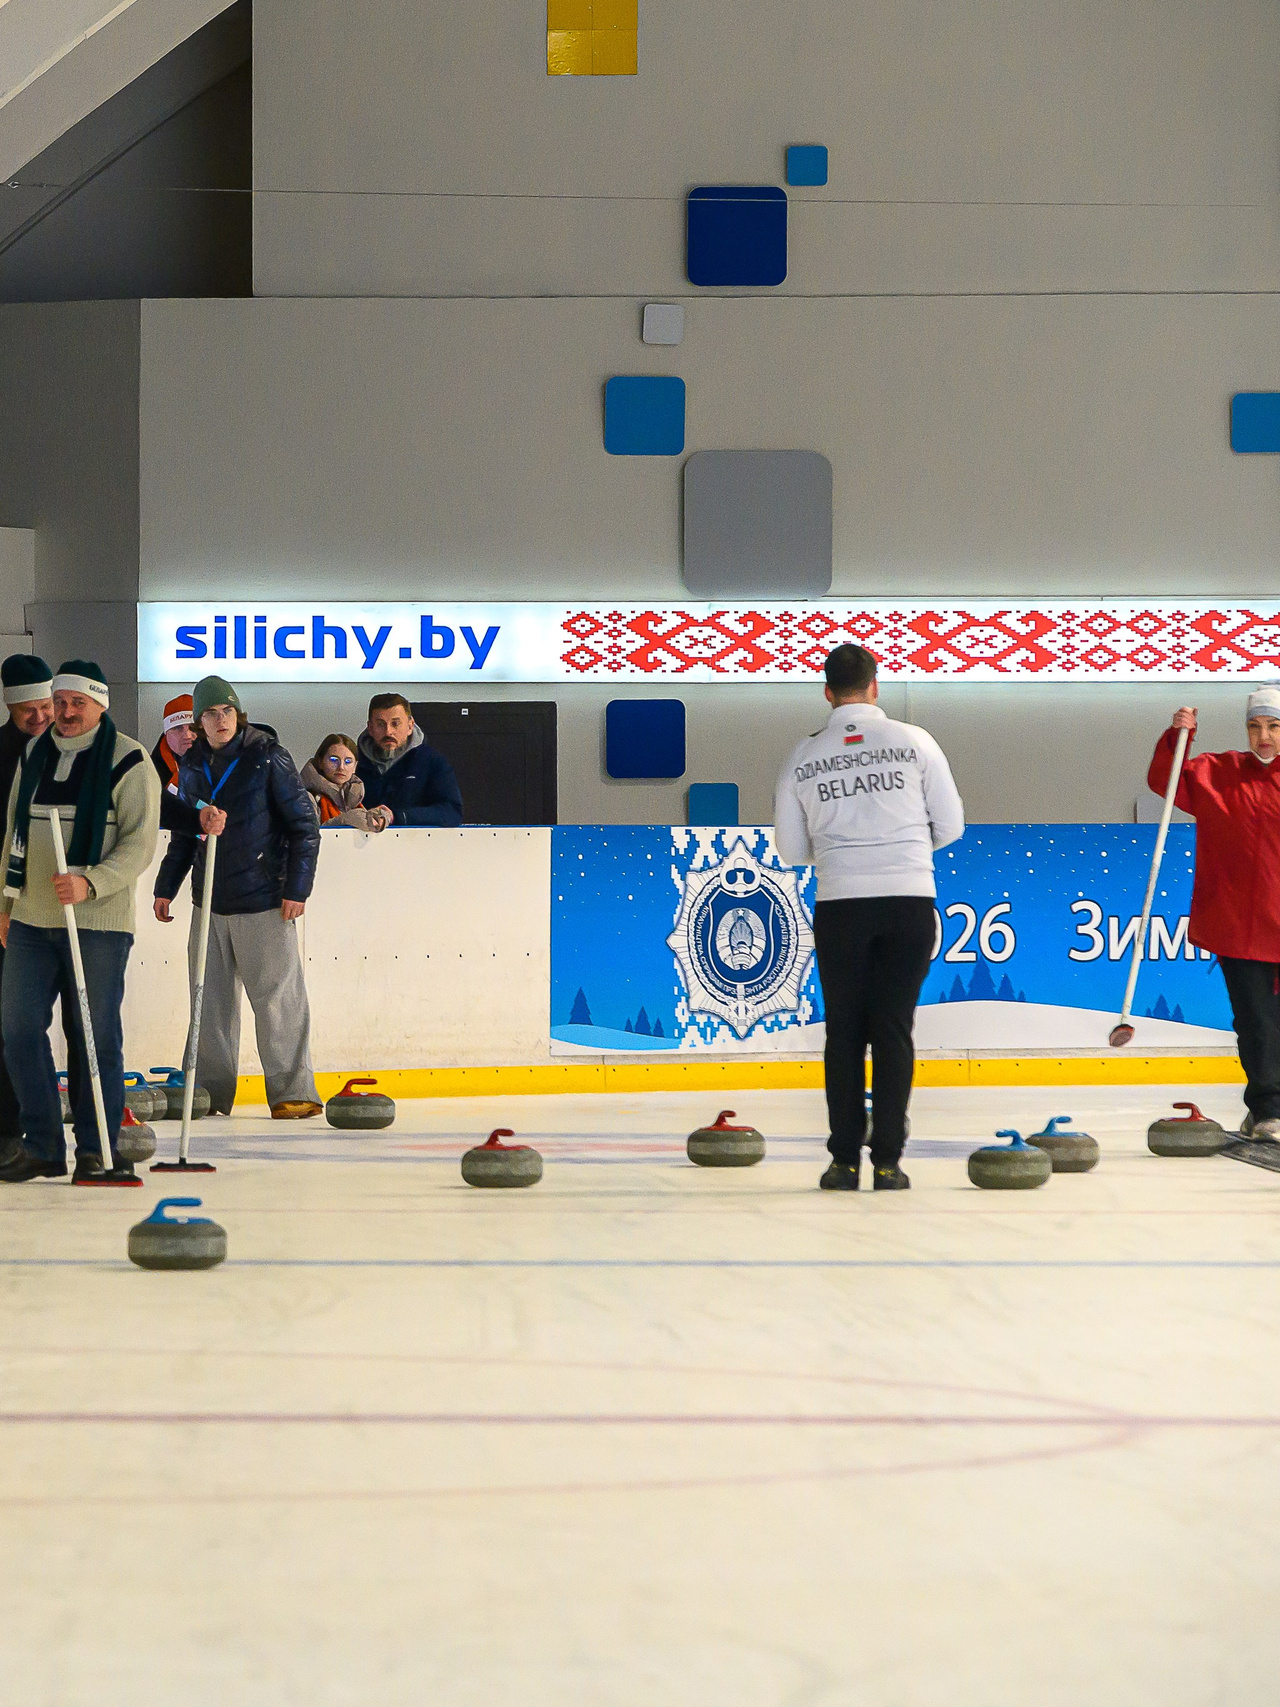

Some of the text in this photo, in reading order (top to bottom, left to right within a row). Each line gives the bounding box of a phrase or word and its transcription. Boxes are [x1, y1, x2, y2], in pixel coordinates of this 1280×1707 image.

[175, 615, 501, 669] silichy.by
[169, 713, 193, 723] БЕЛАРУ
[794, 748, 918, 783] DZIAMESHCHANKA
[817, 771, 905, 802] BELARUS
[1069, 900, 1211, 962] Зим
